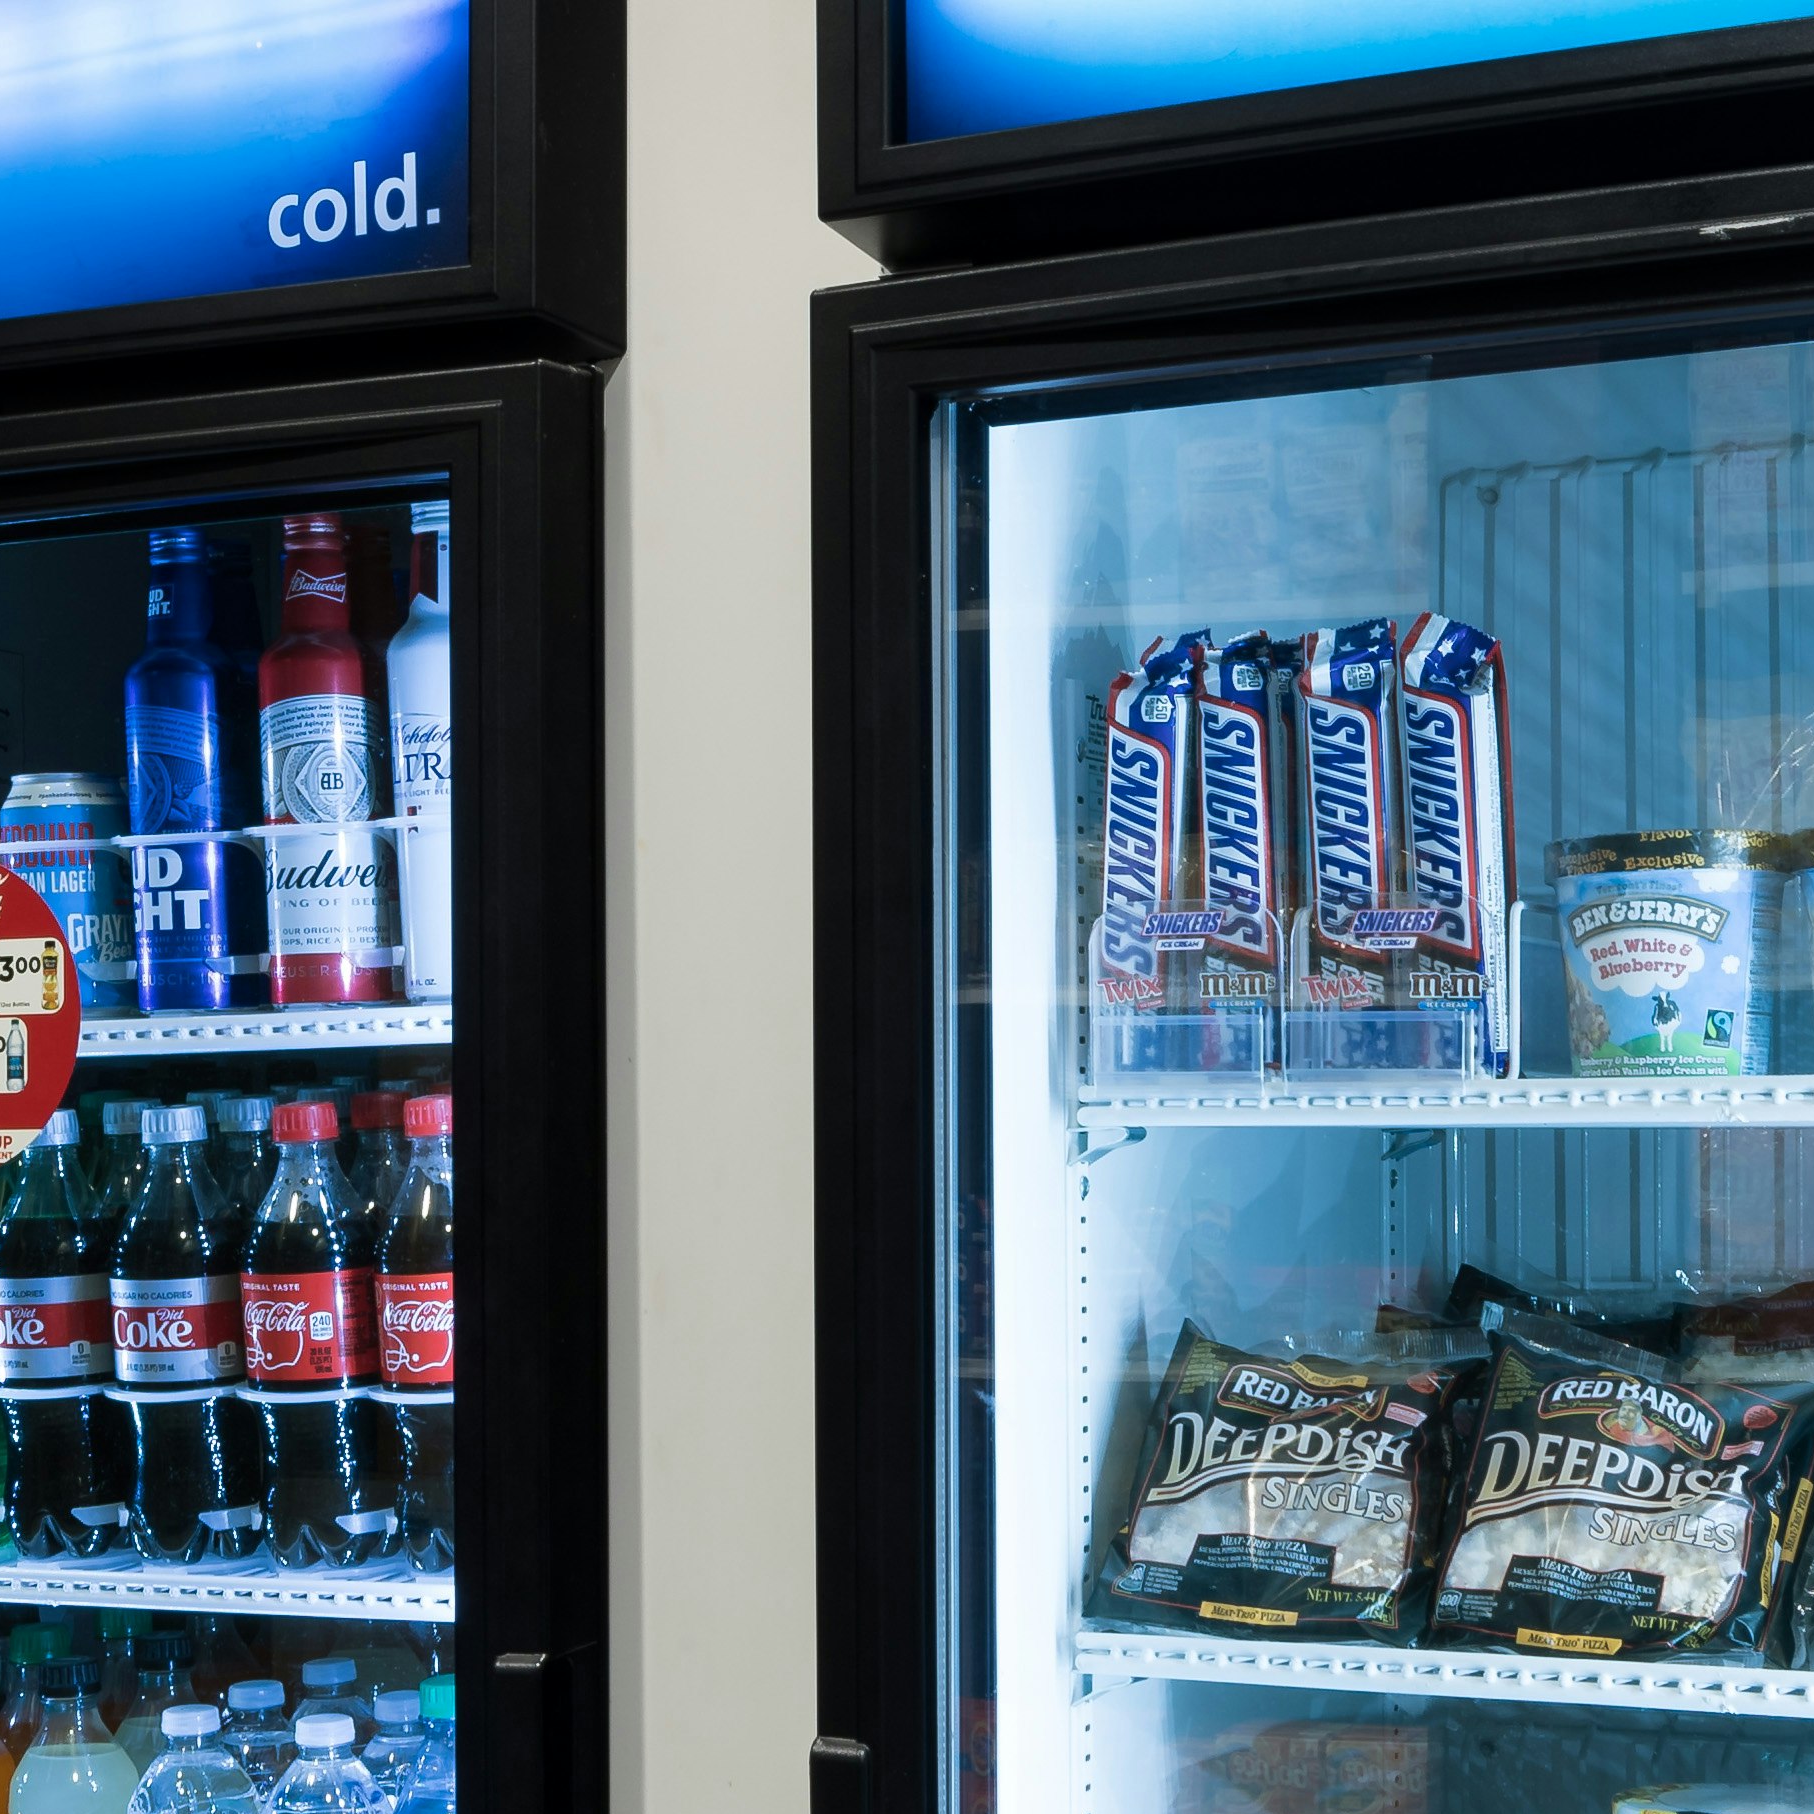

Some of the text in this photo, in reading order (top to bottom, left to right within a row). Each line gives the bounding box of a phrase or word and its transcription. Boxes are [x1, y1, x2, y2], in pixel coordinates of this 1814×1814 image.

[267, 151, 442, 250] cold.
[1624, 853, 1704, 869] Exclusive
[50, 872, 95, 893] LAGER
[1144, 912, 1223, 934] SNICKERS
[1353, 911, 1436, 933] SNICKERS
[1599, 959, 1687, 980] Blueberry
[12, 1307, 36, 1318] Diet
[159, 1309, 183, 1321] Diet
[311, 1315, 332, 1329] 240
[113, 1311, 196, 1349] Coke
[1554, 1379, 1713, 1445] RED BARON
[1262, 1478, 1405, 1522] SINGLES
[1590, 1507, 1737, 1552] SINGLES
[1581, 1638, 1609, 1651] PIZZA
